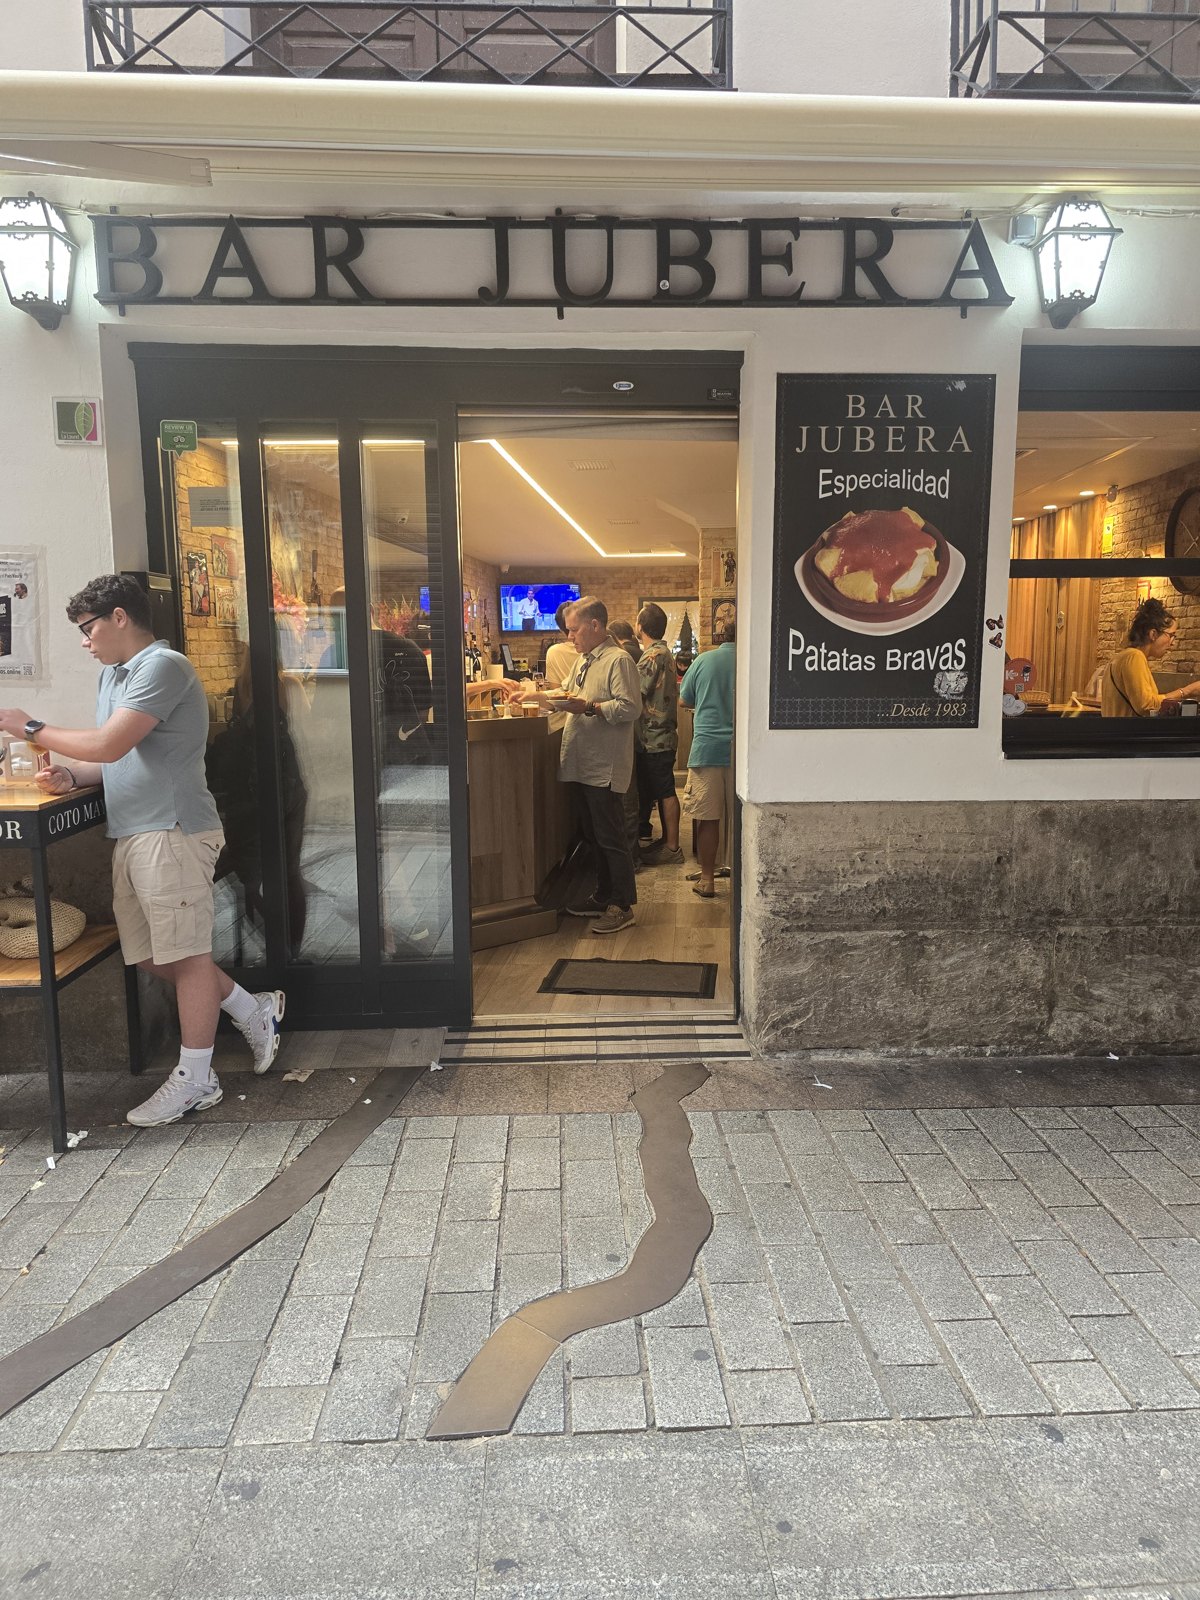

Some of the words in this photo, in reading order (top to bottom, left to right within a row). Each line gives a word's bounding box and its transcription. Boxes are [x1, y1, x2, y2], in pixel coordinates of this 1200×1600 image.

[88, 213, 386, 305] BAR
[477, 215, 1015, 306] JUBERA
[845, 393, 927, 419] BAR
[795, 425, 973, 453] JUBERA
[818, 468, 951, 500] Especialidad
[788, 627, 877, 672] Patatas
[885, 637, 967, 672] Bravas
[934, 702, 968, 717] 1983
[0, 820, 24, 840] R
[48, 807, 81, 835] COTO
